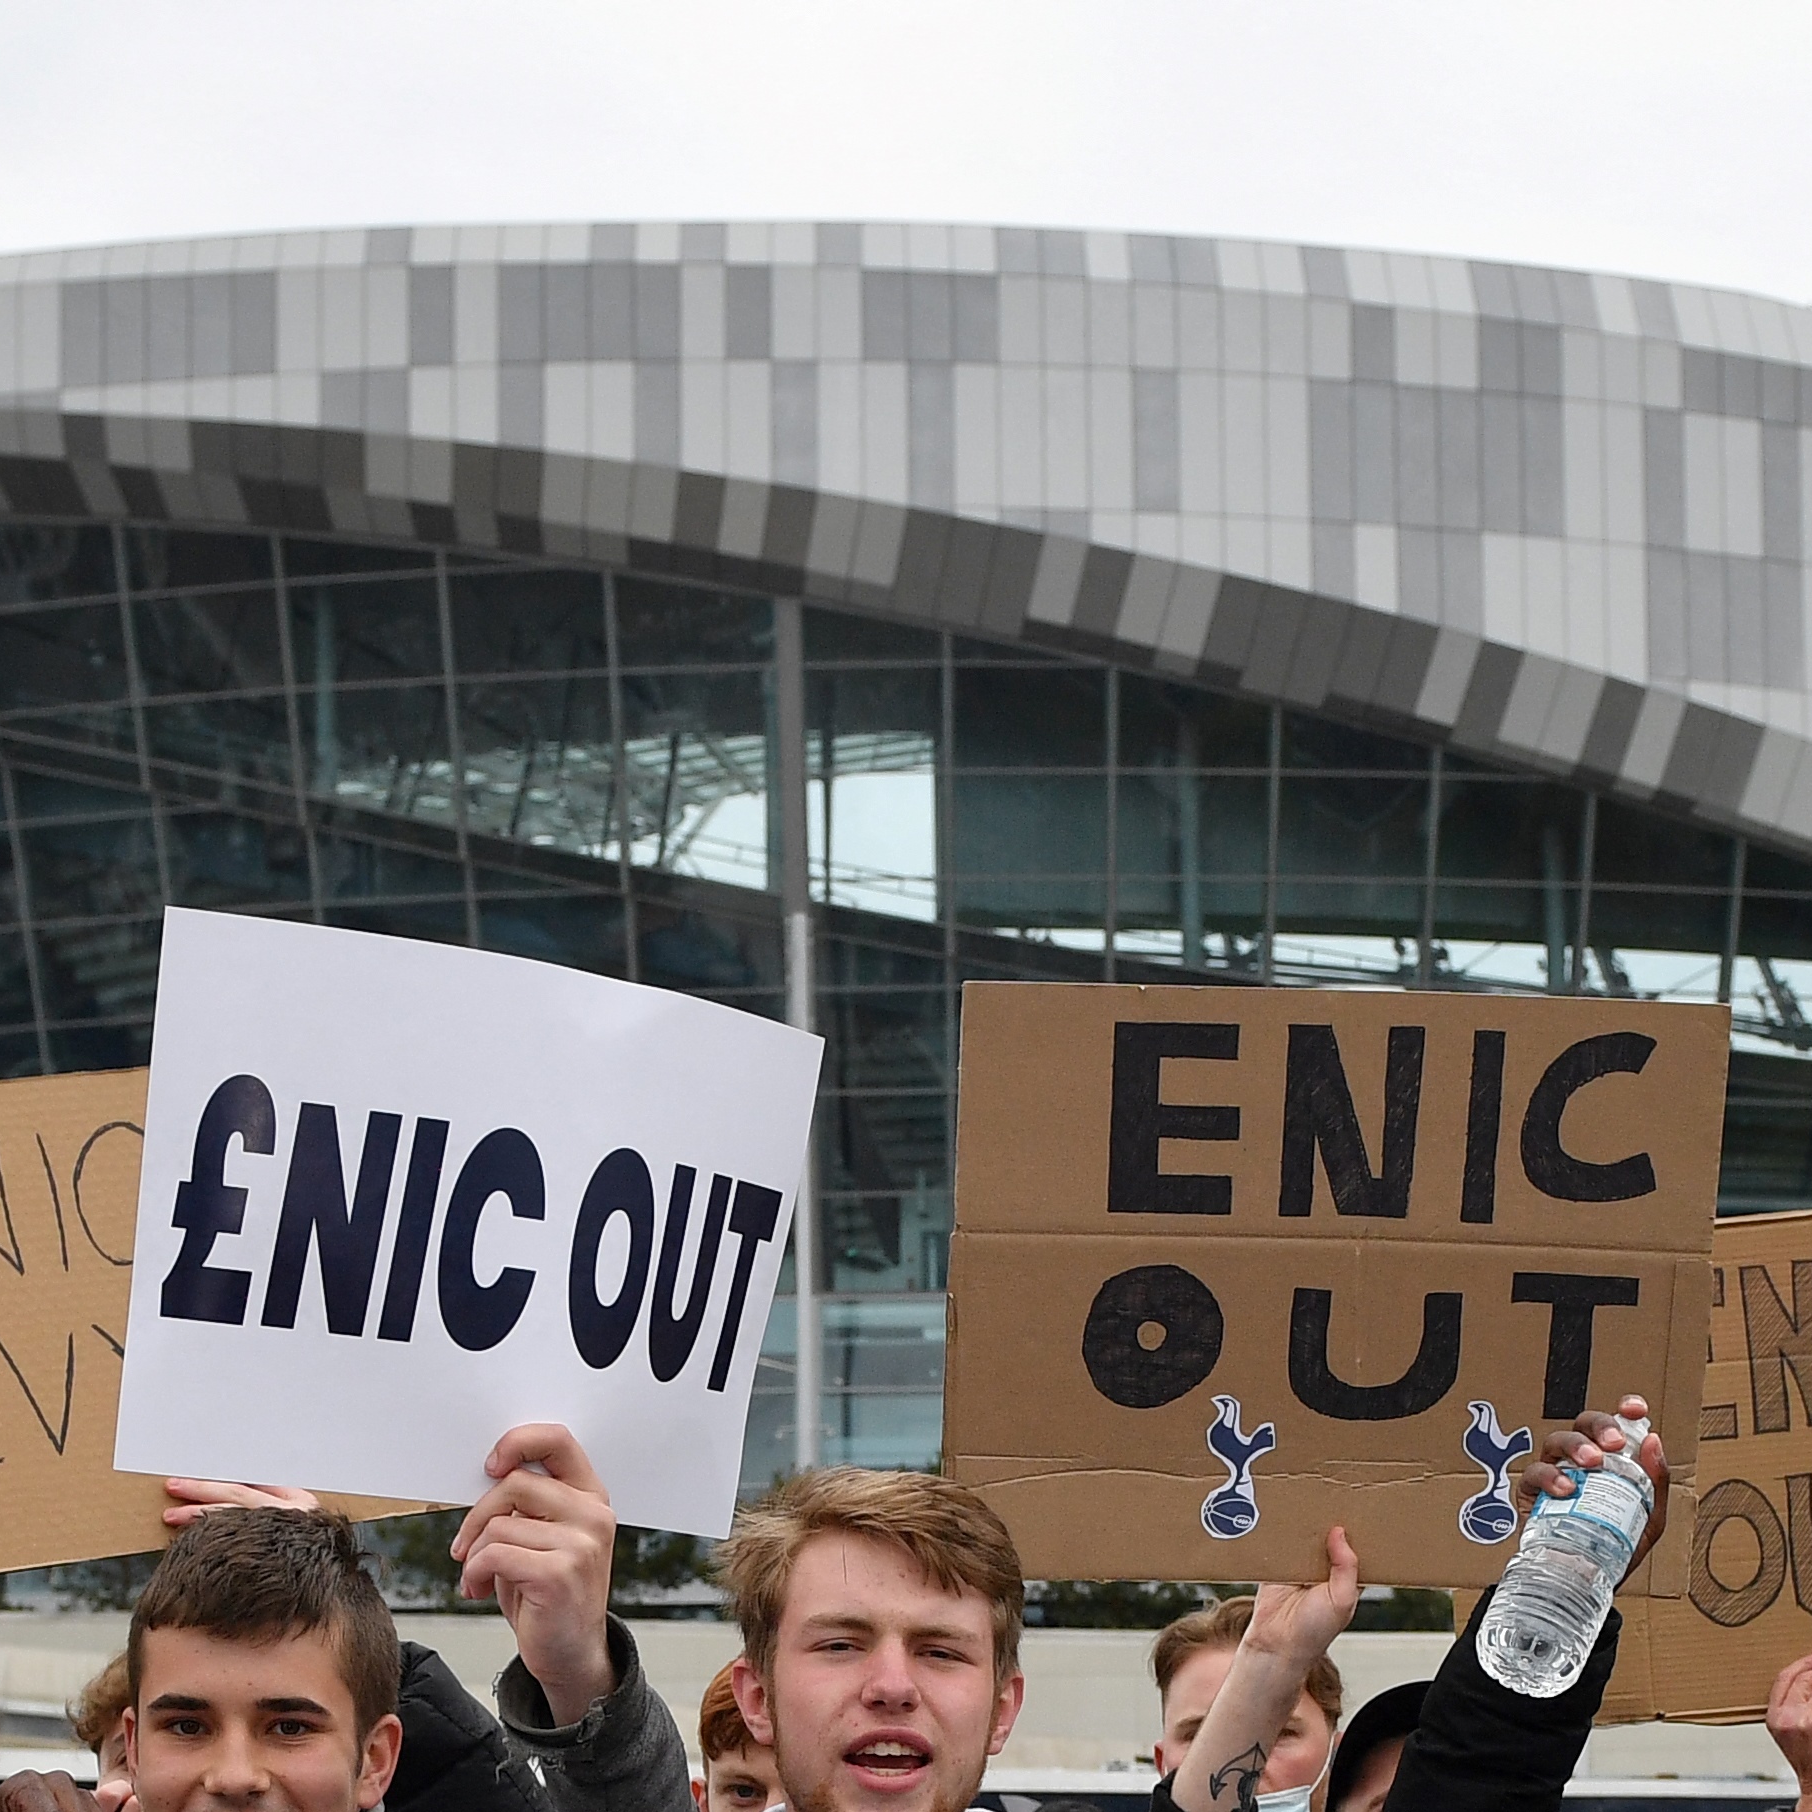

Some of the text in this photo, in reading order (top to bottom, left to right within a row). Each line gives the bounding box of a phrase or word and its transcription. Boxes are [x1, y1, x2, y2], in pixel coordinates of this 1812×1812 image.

[1106, 1021, 1658, 1225] ENIC
[159, 1073, 784, 1394] £NIC OUT
[1081, 1263, 1639, 1421] OUT
